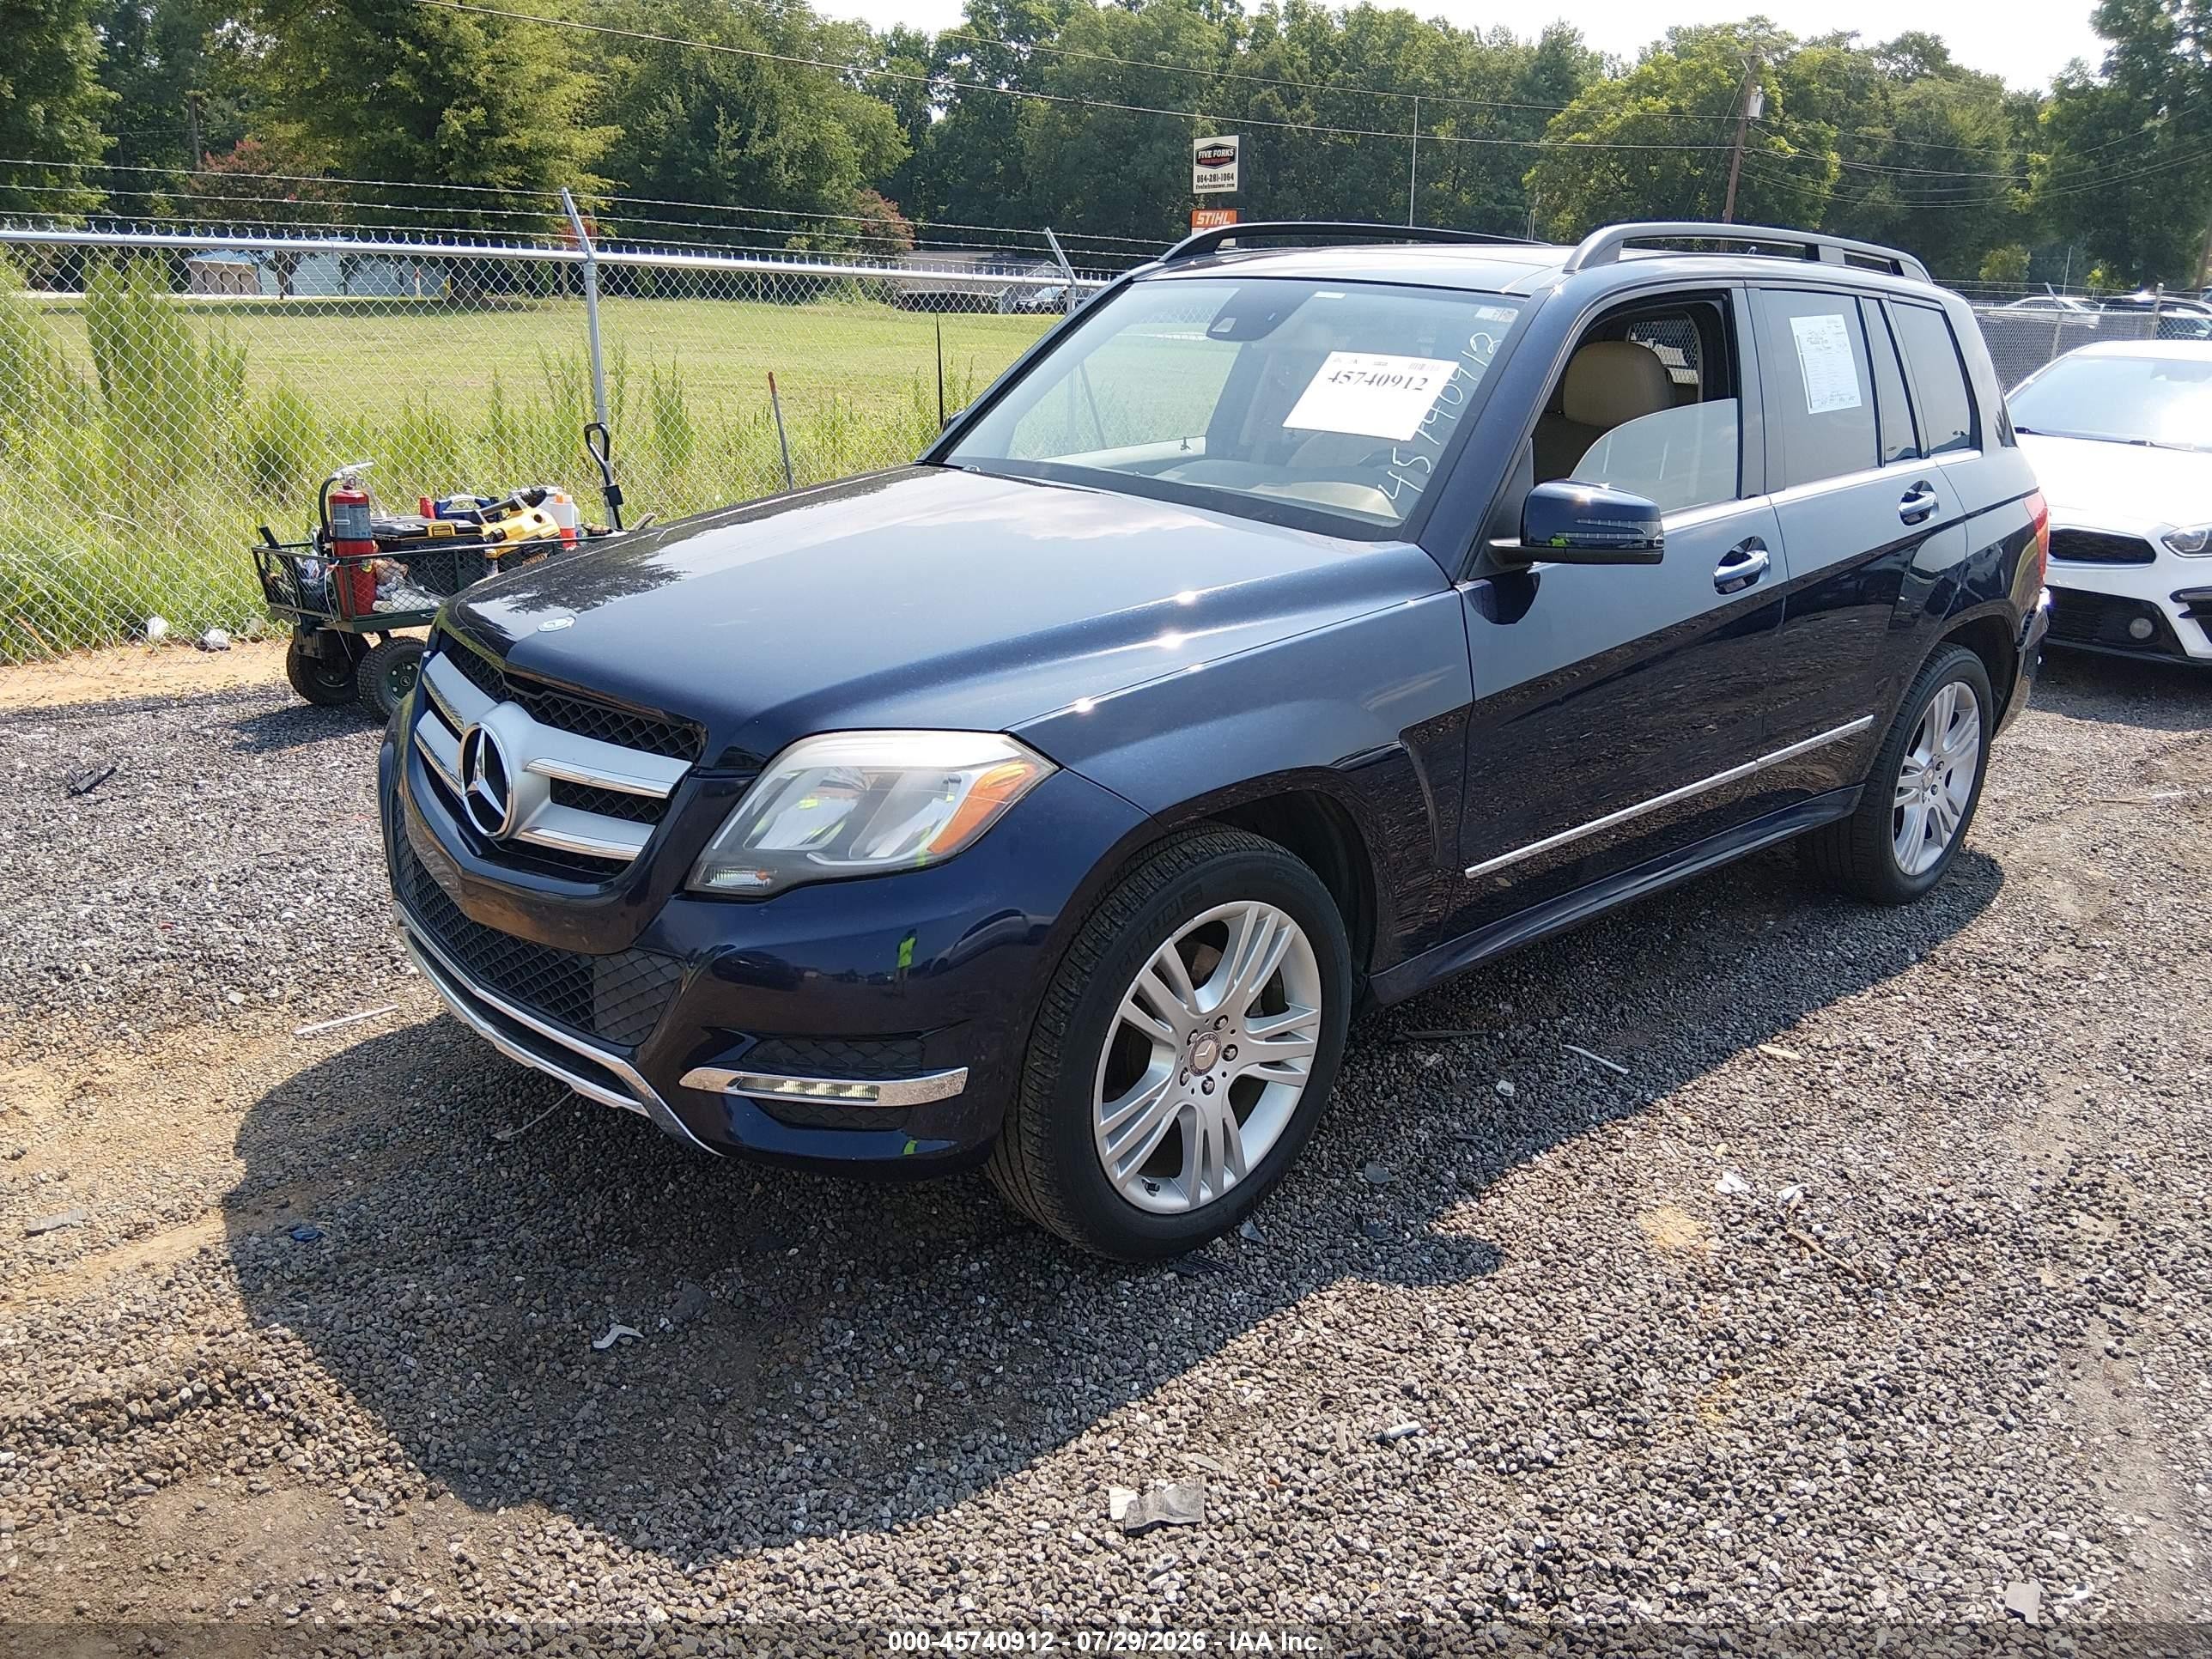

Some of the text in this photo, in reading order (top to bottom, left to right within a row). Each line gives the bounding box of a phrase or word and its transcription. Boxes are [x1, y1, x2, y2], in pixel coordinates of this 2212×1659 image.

[1198, 149, 1234, 159] FIVE FORKS
[1196, 173, 1234, 183] 864-281-1064
[1196, 212, 1230, 225] STIHL
[1328, 370, 1428, 391] 45740912
